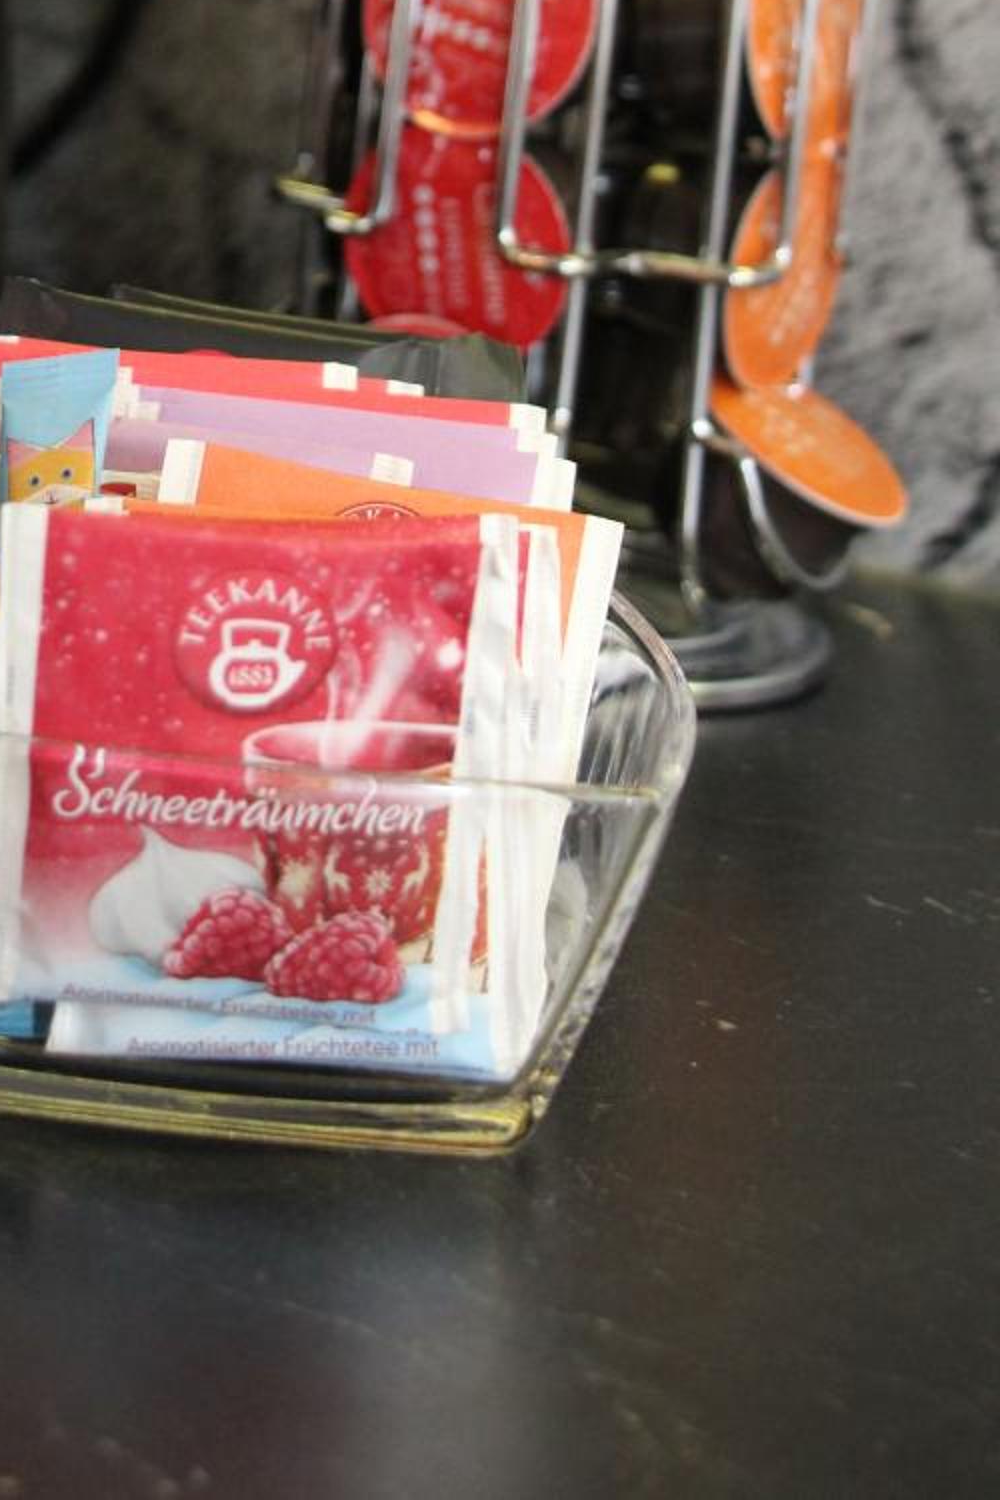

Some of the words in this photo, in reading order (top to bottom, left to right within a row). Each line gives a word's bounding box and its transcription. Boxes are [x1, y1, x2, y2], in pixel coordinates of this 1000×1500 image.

[177, 577, 331, 650] TEEKANNE
[52, 743, 426, 836] Schneeträumchen
[343, 1006, 376, 1024] mit
[127, 1034, 278, 1056] Aromatisierter
[283, 1036, 400, 1057] Fruchtetee
[405, 1039, 439, 1058] mit
